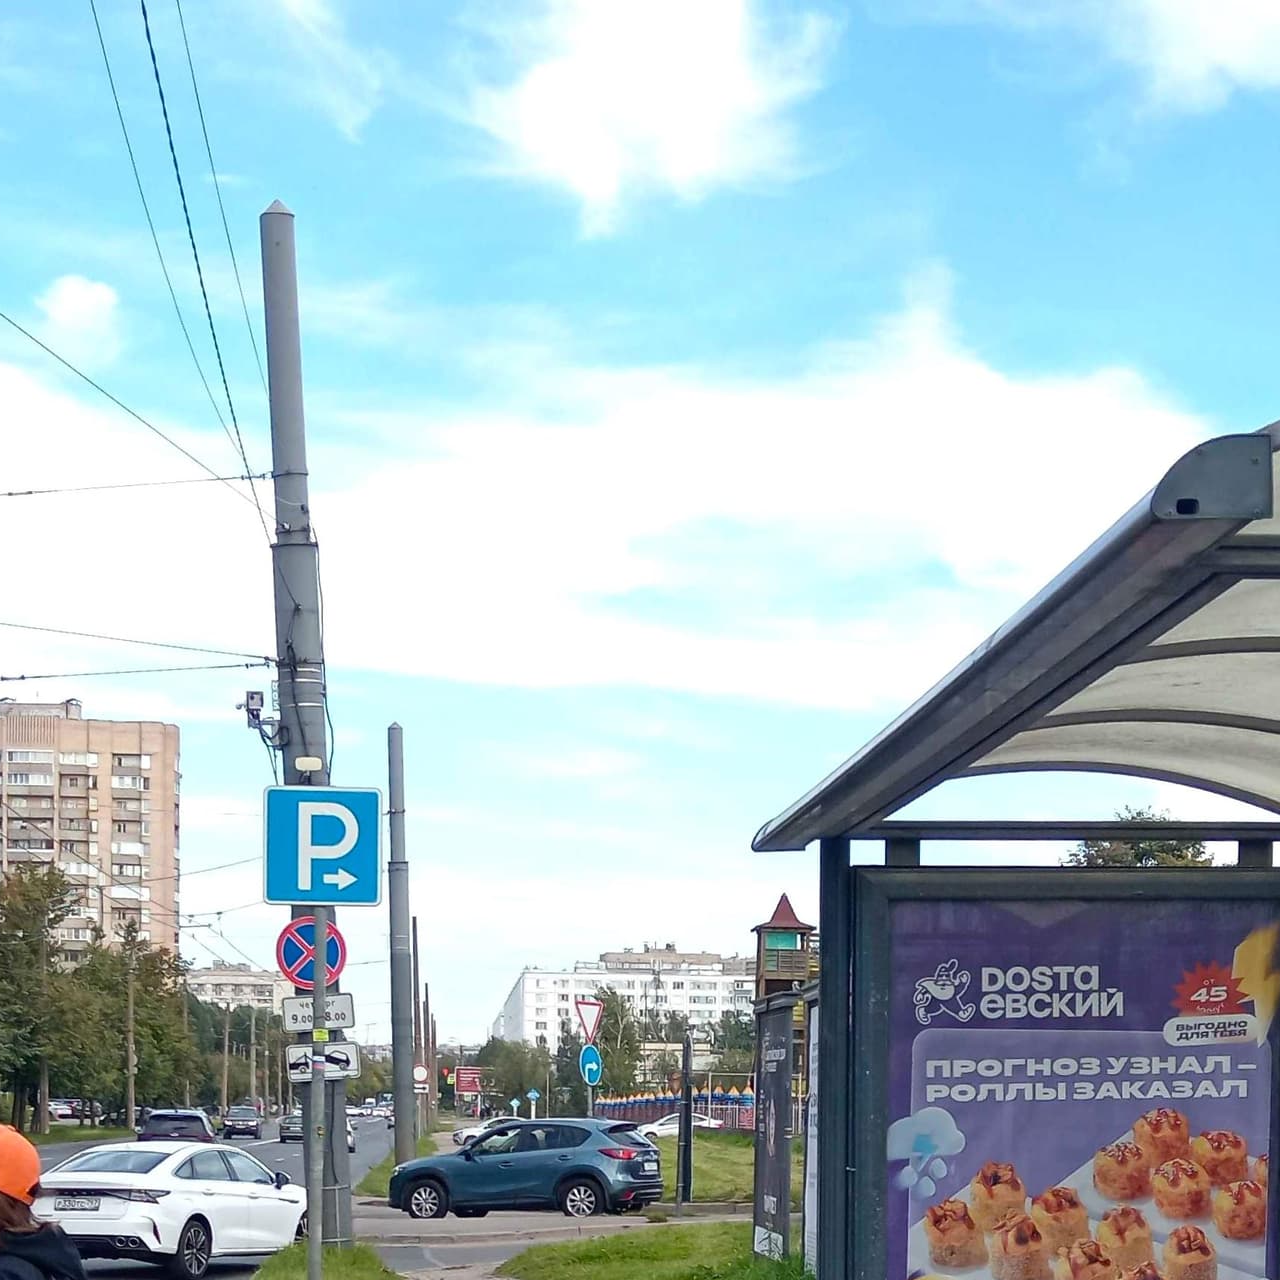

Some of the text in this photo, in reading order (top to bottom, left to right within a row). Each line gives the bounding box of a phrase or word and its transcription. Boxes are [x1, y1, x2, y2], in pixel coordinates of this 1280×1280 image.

[298, 802, 360, 891] P
[1190, 986, 1228, 1002] 45
[1175, 1020, 1248, 1032] ВЫГОДНО
[1176, 1029, 1247, 1042] ДЛЯ ТЕБЯ
[926, 1058, 1101, 1078] ПРОГНОЗ
[1106, 1055, 1231, 1076] УЗНАЛ
[926, 1079, 1248, 1102] РОЛЛЫ ЗАКАЗАЛ
